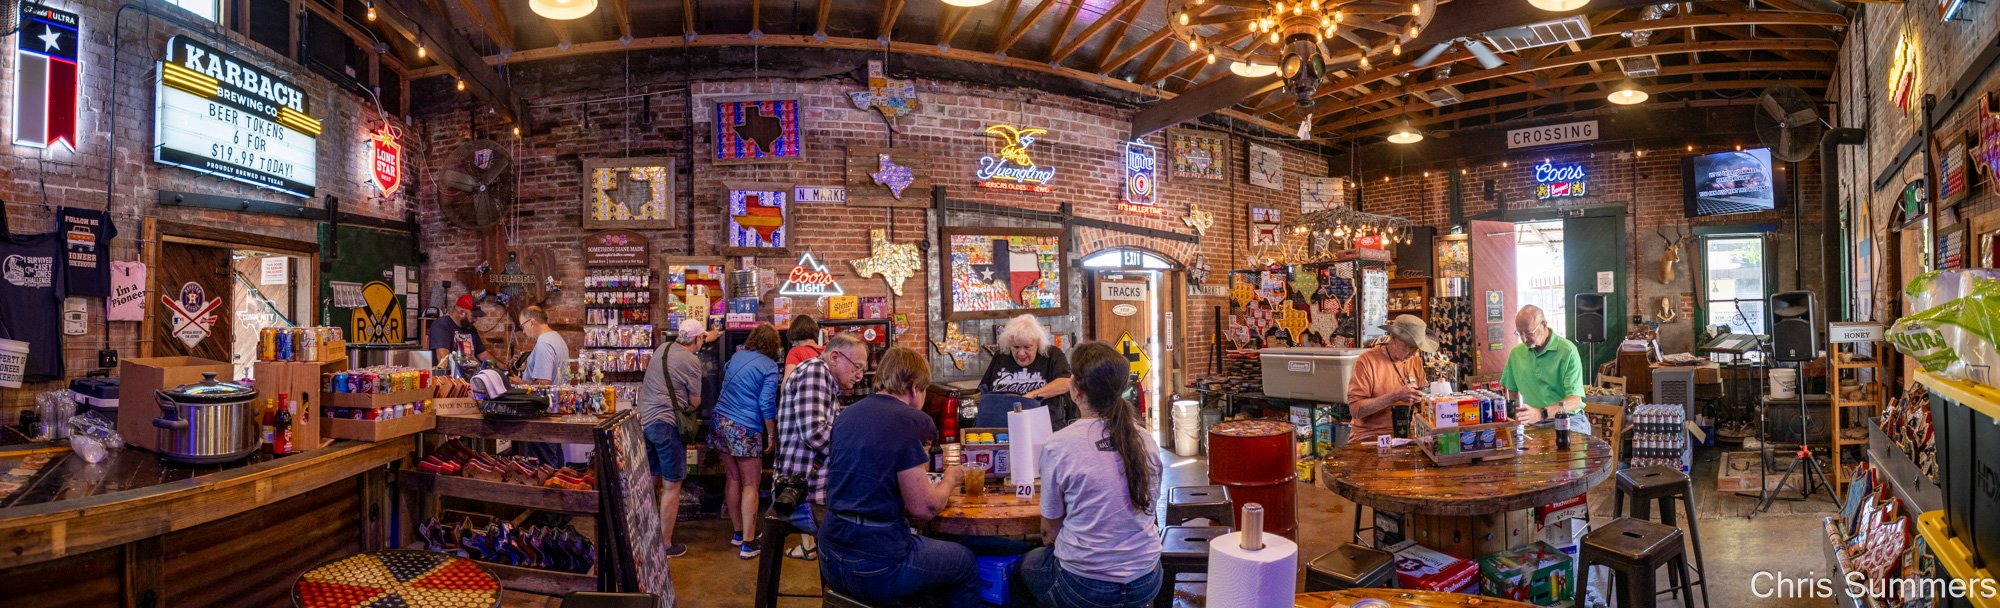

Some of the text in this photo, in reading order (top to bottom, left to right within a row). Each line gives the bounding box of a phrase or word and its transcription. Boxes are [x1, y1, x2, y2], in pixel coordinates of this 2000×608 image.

[52, 12, 75, 24] ULTRA
[185, 44, 303, 113] KARBACH
[217, 87, 263, 112] BREWING
[209, 103, 284, 141] BEER TOKENS
[233, 130, 267, 152] 6 FOR
[1513, 124, 1592, 145] CROSSING
[211, 143, 294, 178] $19.99 TODAY!
[377, 149, 396, 165] LONE
[1128, 151, 1154, 172] Lite
[206, 161, 284, 186] PROUDLY BREWED IN TEXAS
[377, 161, 396, 177] STAR
[977, 156, 1055, 185] Yuengling
[1536, 163, 1585, 182] Coors
[799, 189, 845, 201] N. MARKE
[1118, 203, 1163, 215] IT'S MILLER TIME
[65, 216, 89, 225] FOLLOW
[27, 256, 53, 264] SURVIVED
[1124, 251, 1140, 265] EXIT
[34, 263, 52, 271] CASEY
[789, 265, 834, 285] Coors
[116, 285, 130, 297] I'm
[796, 283, 825, 292] LIGHT
[1108, 286, 1141, 297] TRACKS
[112, 290, 145, 308] Pioneer
[834, 301, 854, 311] Shiner
[357, 318, 399, 341] R R
[1381, 437, 1390, 445] 18
[1018, 486, 1031, 495] 20
[1552, 497, 1580, 508] Budweiser
[1443, 575, 1472, 593] Budweiser
